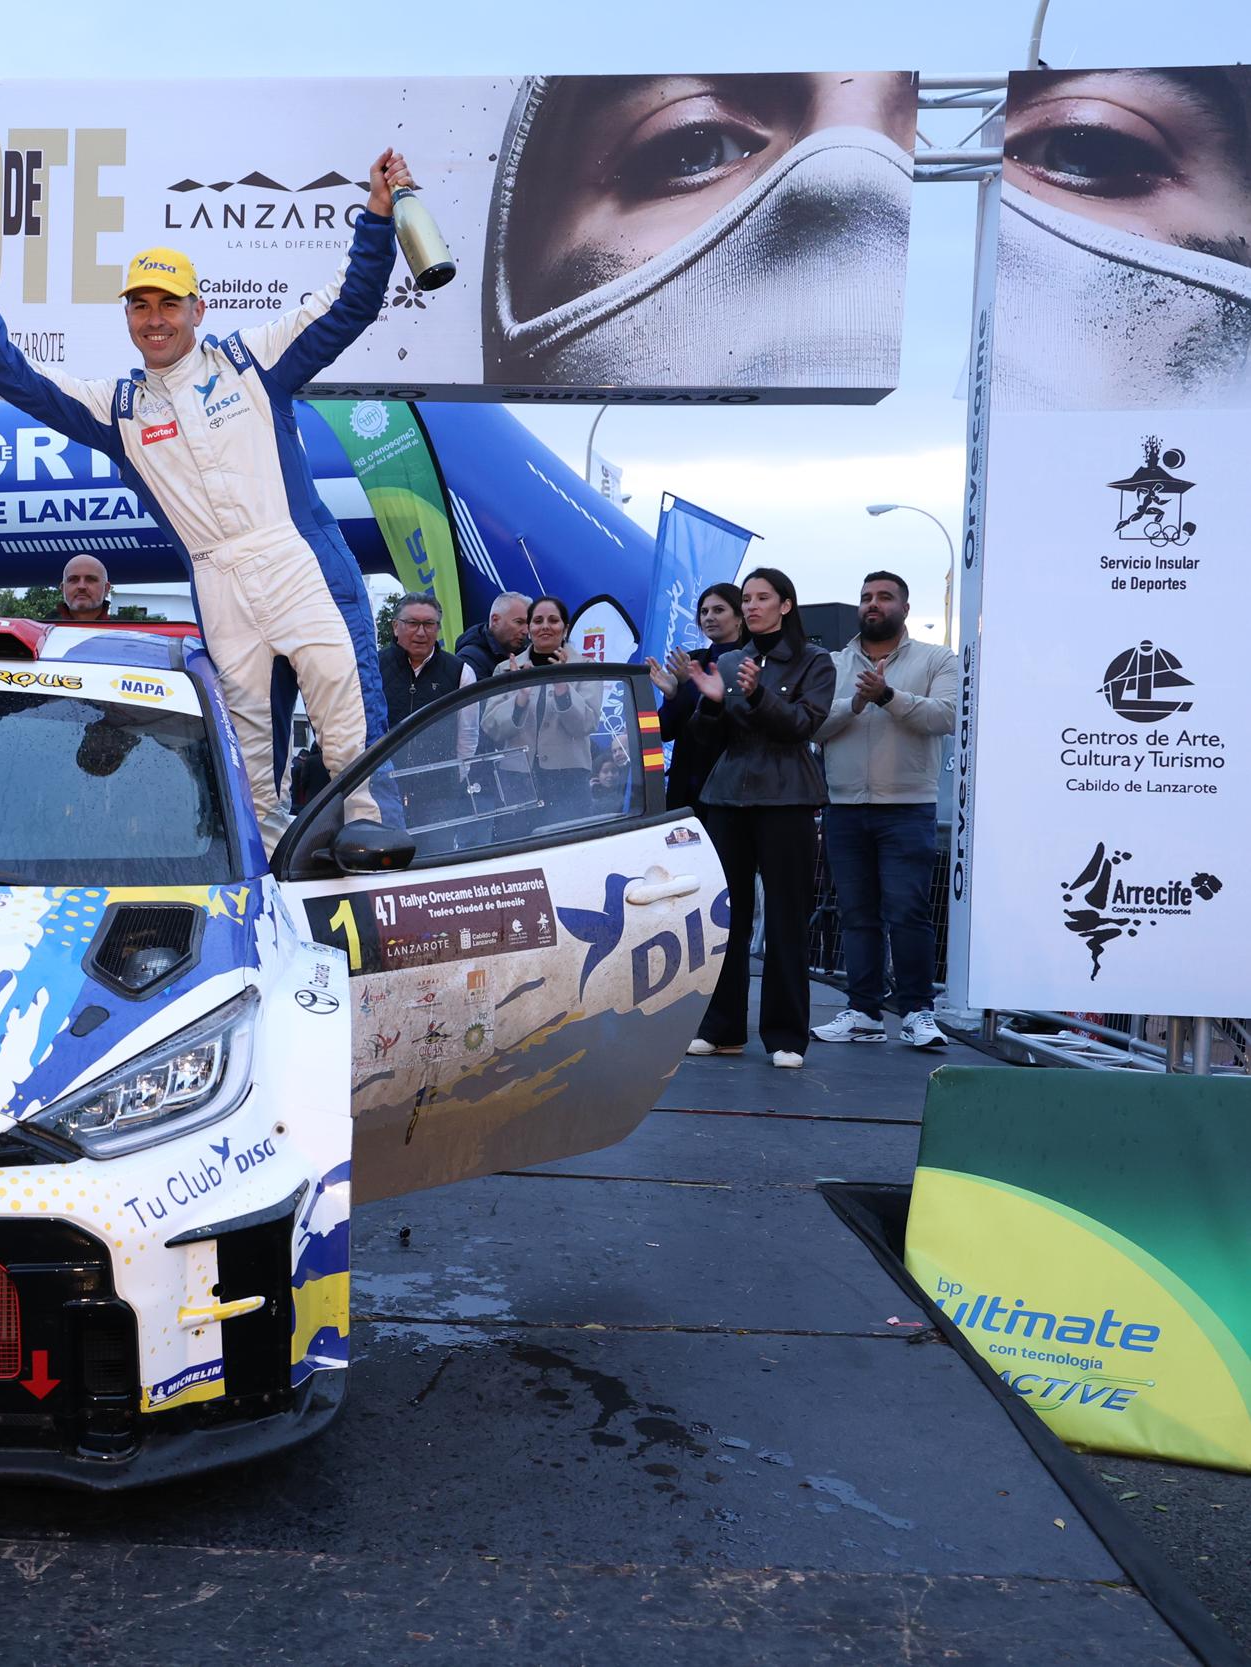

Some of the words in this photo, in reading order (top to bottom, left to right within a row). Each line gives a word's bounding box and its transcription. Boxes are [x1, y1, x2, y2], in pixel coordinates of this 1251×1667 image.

[2, 148, 43, 236] DE
[165, 203, 365, 229] LANZARO
[227, 240, 243, 249] LA
[250, 240, 279, 249] ISLA
[285, 240, 349, 249] DIFERENT
[200, 279, 262, 293] Cabildo
[264, 279, 288, 293] de
[205, 392, 241, 417] DISA
[146, 428, 175, 439] worten
[964, 307, 988, 571] Orvecame
[1100, 556, 1151, 570] Servicio
[1155, 556, 1200, 570] Insular
[1111, 577, 1127, 590] de
[1130, 577, 1187, 593] Deportes
[121, 679, 166, 697] NAPA
[1061, 728, 1138, 745] Centros
[1145, 729, 1169, 746] de
[1176, 730, 1225, 749] Arte,
[1060, 749, 1131, 767] Cultura
[1134, 755, 1145, 772] y
[1148, 751, 1225, 768] Turismo
[953, 643, 971, 902] Orvecame
[1066, 779, 1120, 792] Cabildo
[1124, 780, 1142, 792] de
[1147, 780, 1218, 794] Lanzarote
[374, 894, 398, 927] 47
[399, 893, 428, 909] Rallye
[428, 888, 474, 904] Orvecame
[474, 885, 489, 898] Isla
[491, 883, 502, 895] de
[502, 878, 545, 894] Lanzarote
[1112, 879, 1192, 906] Arrecife
[428, 907, 455, 919] Trofeo
[485, 902, 495, 911] de
[329, 899, 362, 970] 1
[387, 939, 450, 957] LANZAROTE
[123, 1196, 168, 1229] Tu
[166, 1158, 222, 1208] Club
[235, 1136, 277, 1174] DISA
[936, 1276, 963, 1298] bp
[988, 1341, 1017, 1357] con
[1021, 1346, 1103, 1371] tecnología
[167, 1364, 222, 1396] MICHELIN
